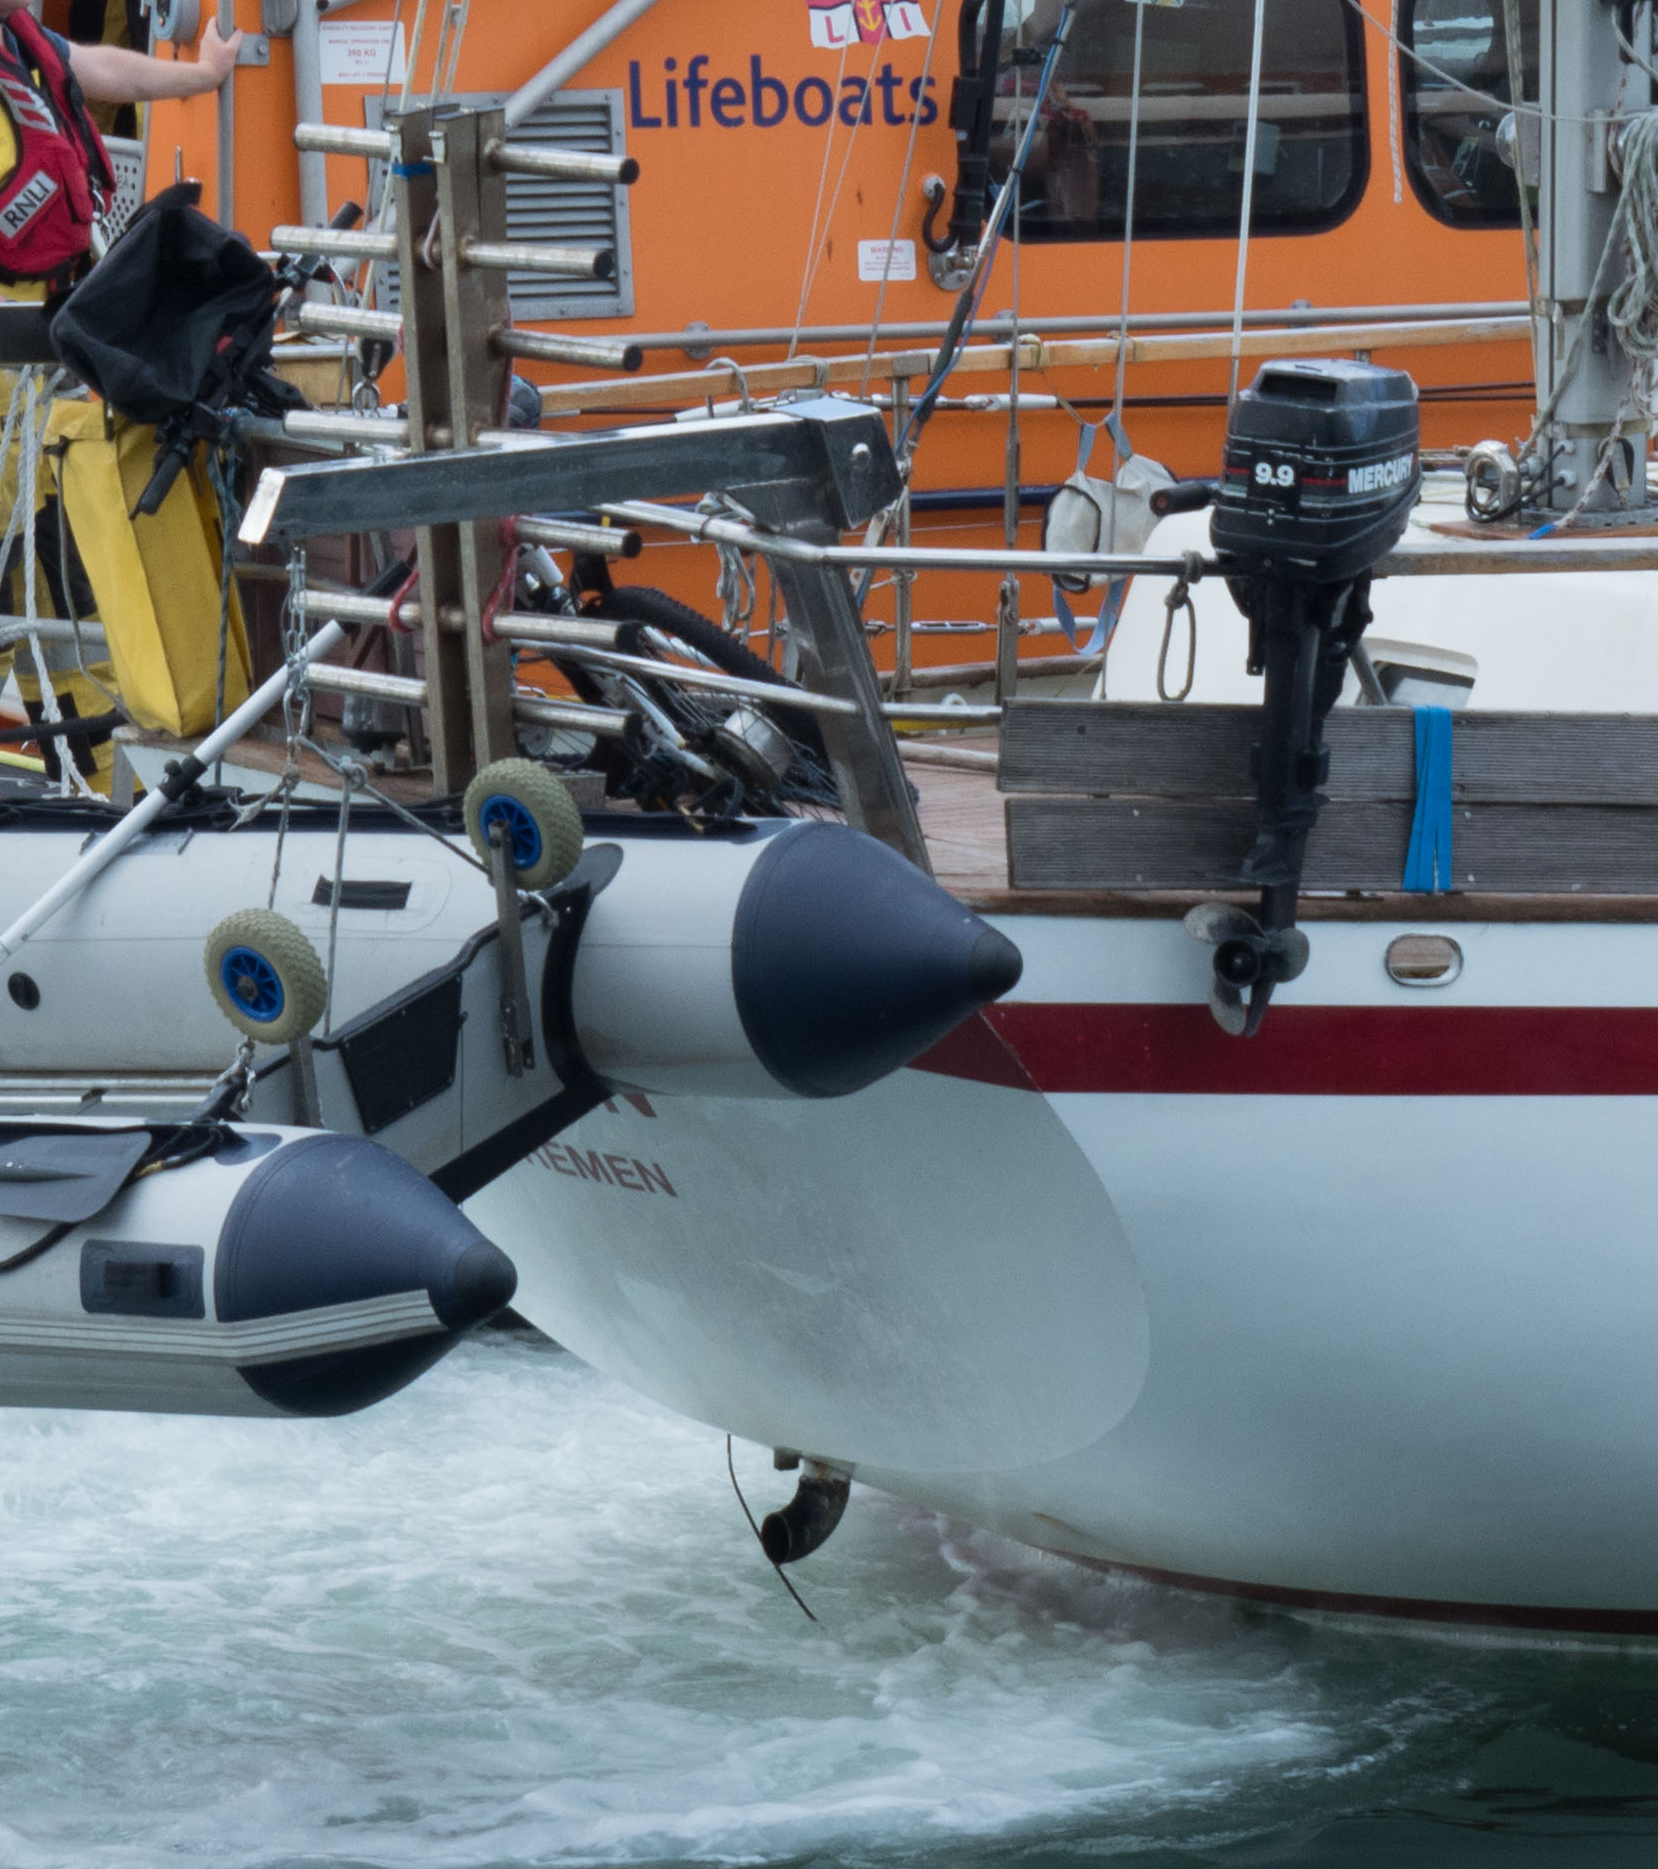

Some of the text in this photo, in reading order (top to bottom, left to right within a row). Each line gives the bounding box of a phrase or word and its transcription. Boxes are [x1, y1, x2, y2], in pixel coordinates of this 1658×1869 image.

[629, 54, 938, 129] Lifeboats
[3, 179, 50, 230] RNLI
[1255, 453, 1414, 494] 9.9 MERCURY
